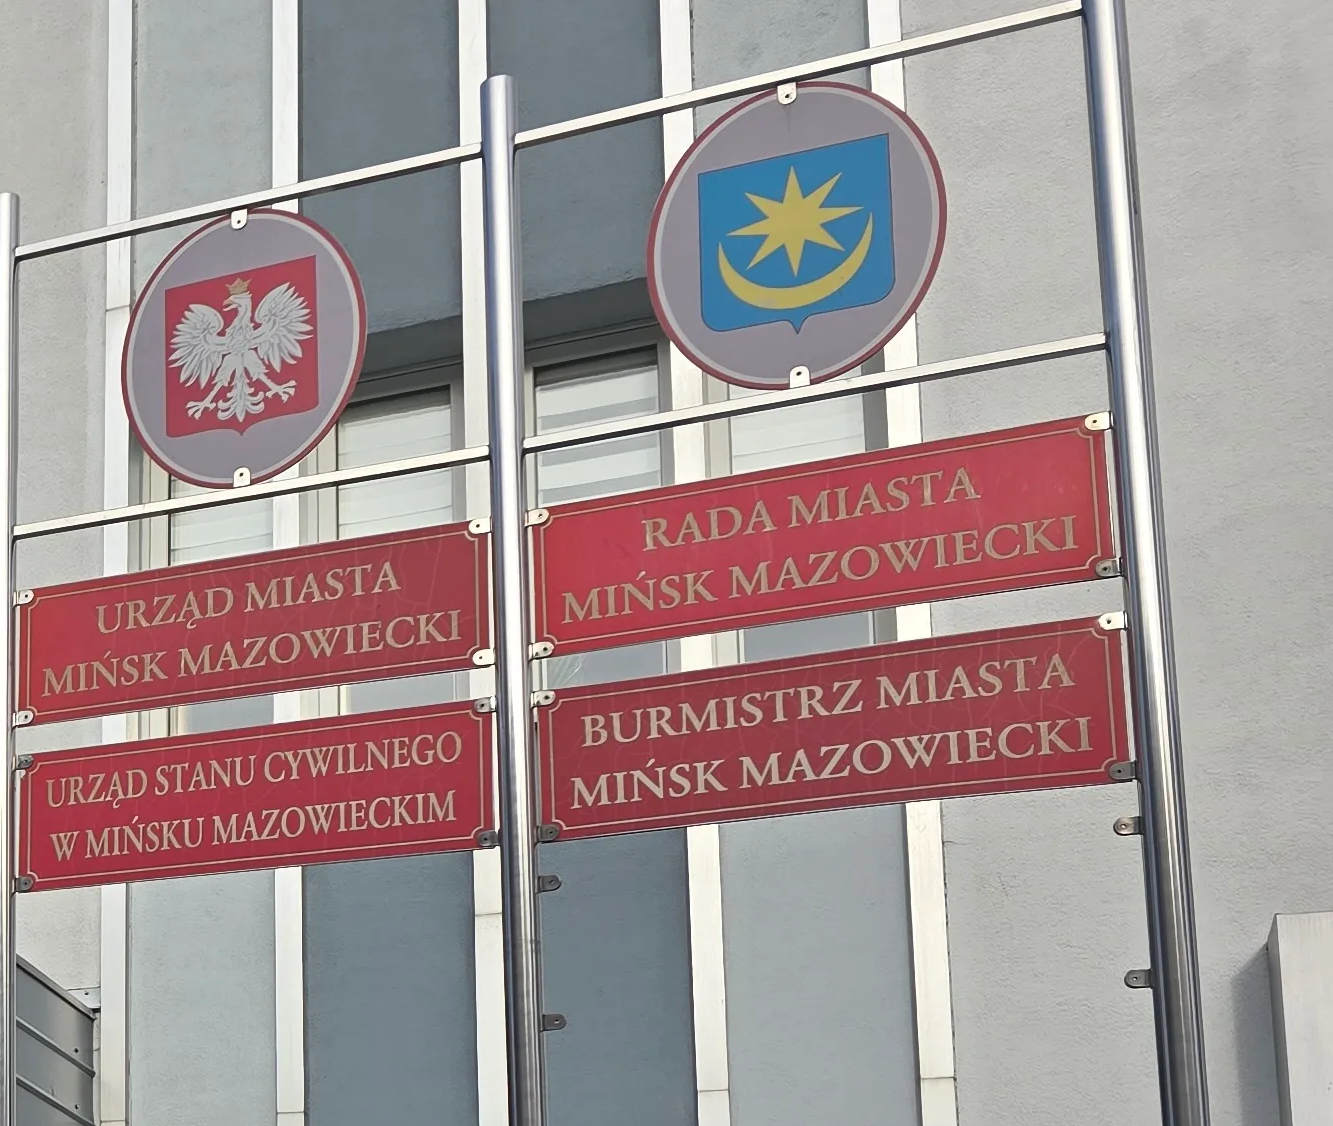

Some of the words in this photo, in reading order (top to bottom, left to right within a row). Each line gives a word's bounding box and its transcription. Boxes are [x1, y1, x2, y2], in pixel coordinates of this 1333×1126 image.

[642, 499, 780, 553] RADA
[787, 466, 981, 530] MIASTA
[95, 587, 234, 635] URZĄD
[242, 560, 401, 614] MIASTA
[561, 570, 718, 625] MIŃSK
[727, 514, 1081, 599] MAZOWIECKI
[41, 648, 169, 698] MIŃSK
[178, 609, 462, 678] MAZOWIECKI
[581, 680, 865, 749] BURMISTRZ
[876, 652, 1077, 711] MIASTA
[45, 768, 149, 810] URZĄD
[153, 754, 258, 797] STANU
[263, 730, 464, 784] CYWILNEGO
[569, 759, 728, 811] MIŃSK
[738, 716, 1094, 790] MAZOWIECKI
[49, 831, 80, 862] W
[83, 815, 205, 860] MIŃSKU
[211, 789, 458, 846] MAZOWIECKIM
